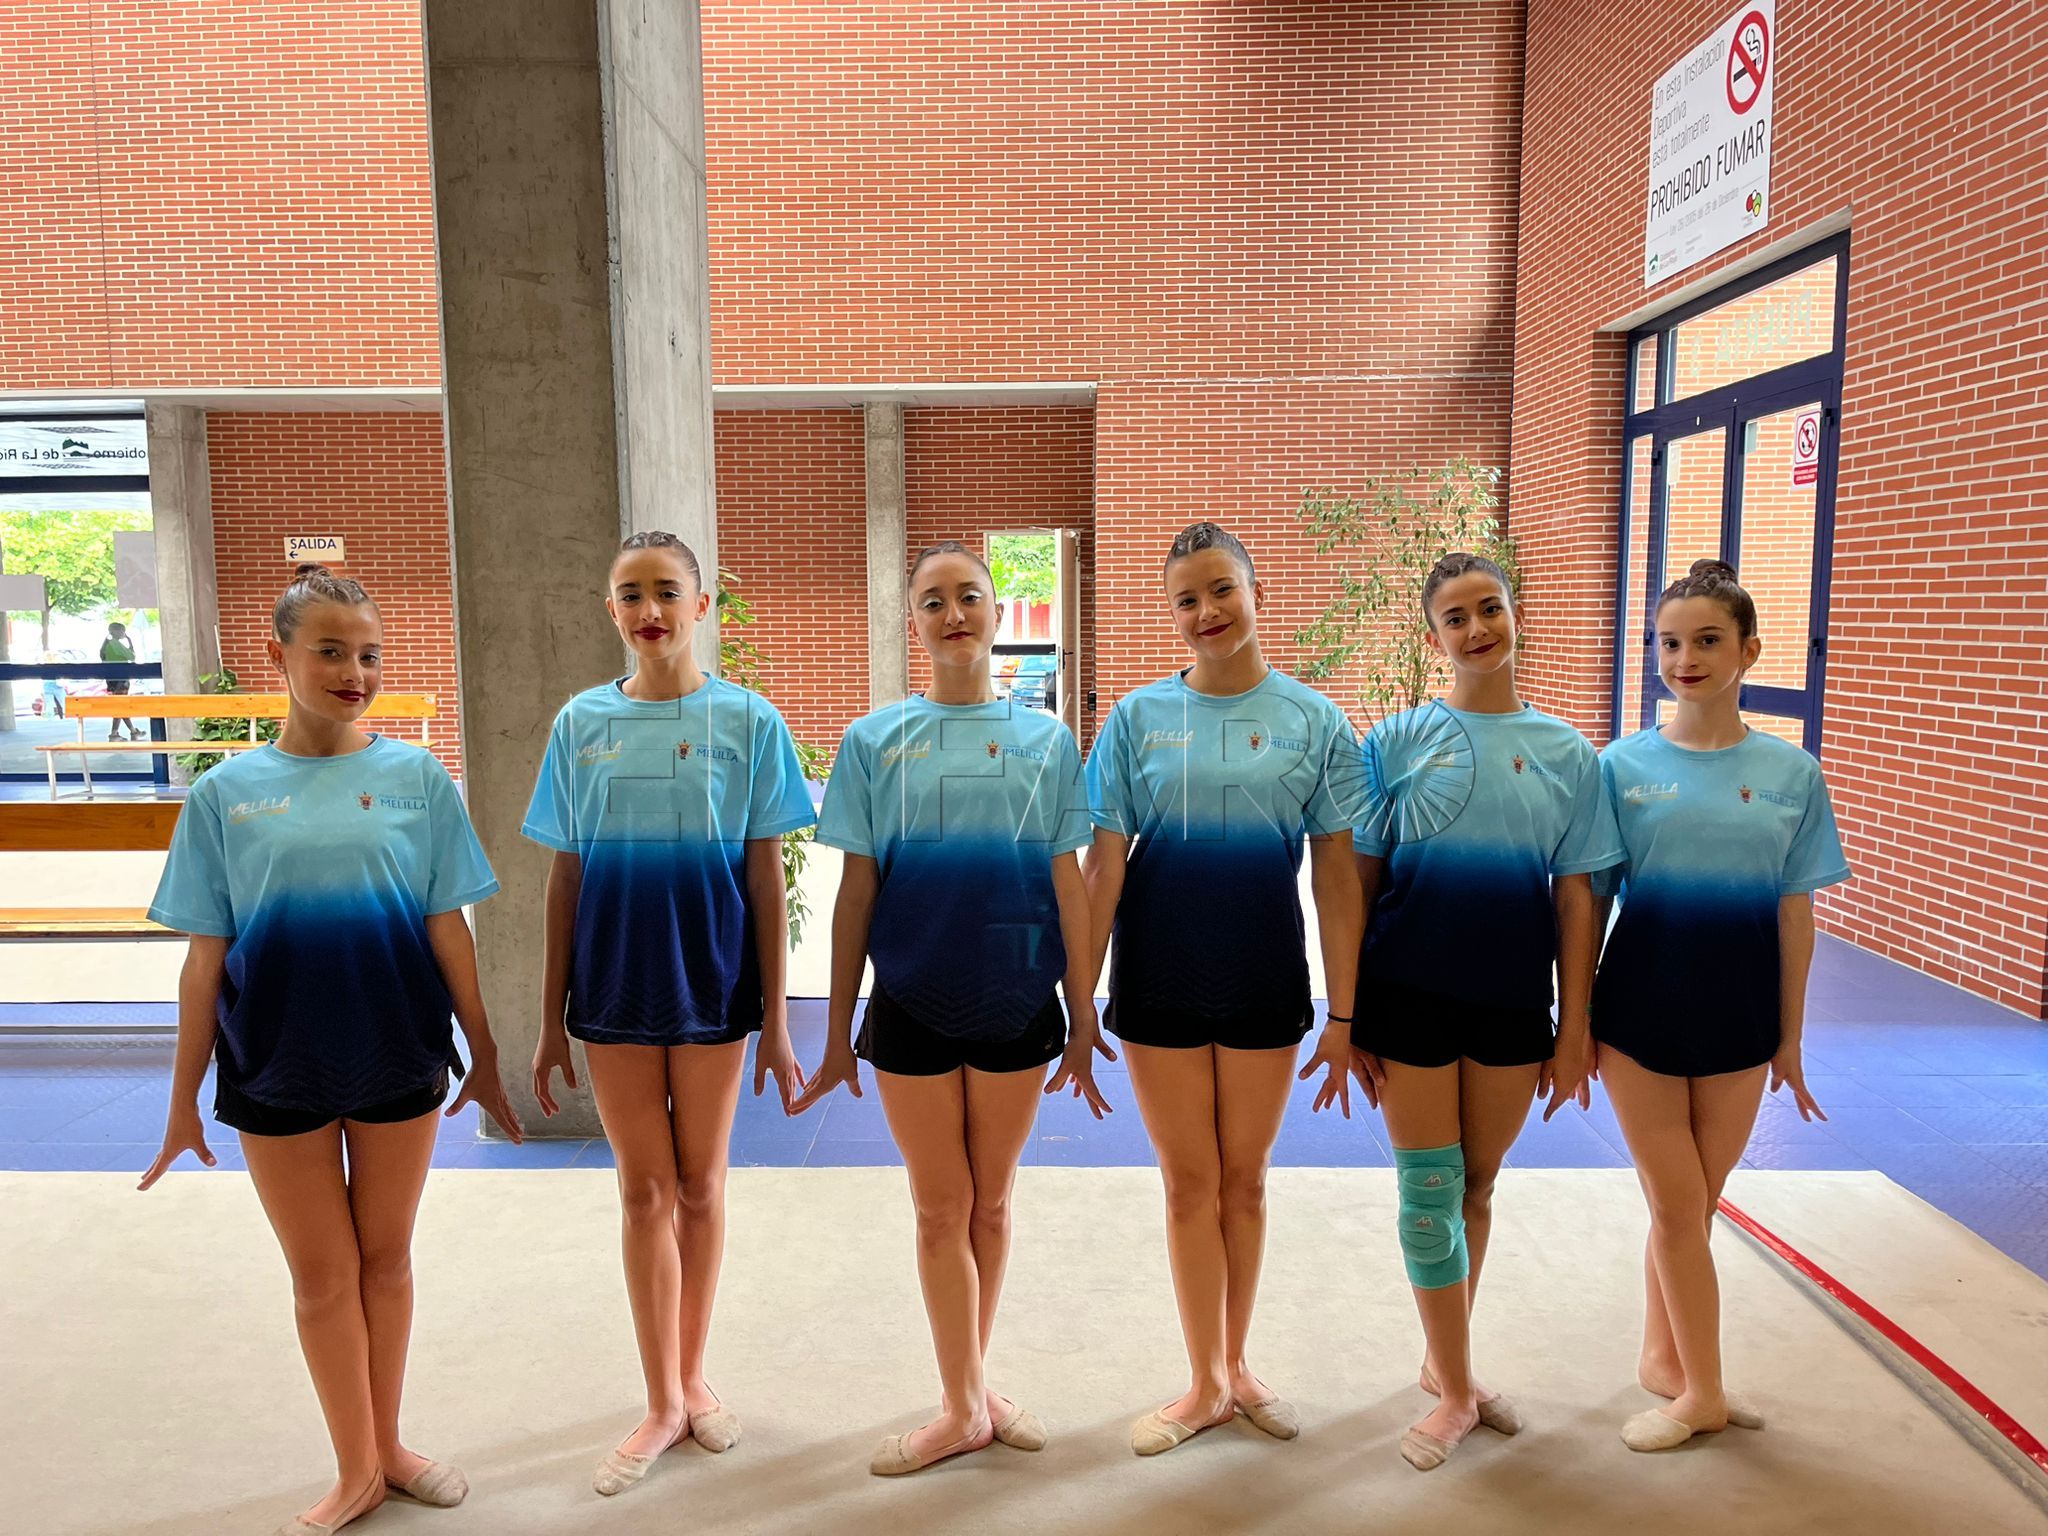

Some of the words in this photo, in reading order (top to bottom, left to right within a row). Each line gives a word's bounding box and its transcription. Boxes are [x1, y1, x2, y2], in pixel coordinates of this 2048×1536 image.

[1655, 86, 1664, 111] En
[1666, 75, 1682, 101] esta
[1653, 100, 1687, 140] Deportiva
[1671, 113, 1710, 157] totalmente
[1650, 154, 1711, 222] PROHIBIDO
[1716, 118, 1765, 181] FUMAR
[290, 538, 336, 549] SALIDA
[696, 748, 738, 763] MELILLA
[880, 739, 932, 760] MELILLA
[1005, 748, 1046, 762] MELILLA
[1624, 782, 1679, 800] MELILLA
[227, 795, 291, 817] MELILLA
[379, 799, 427, 811] MELILLA
